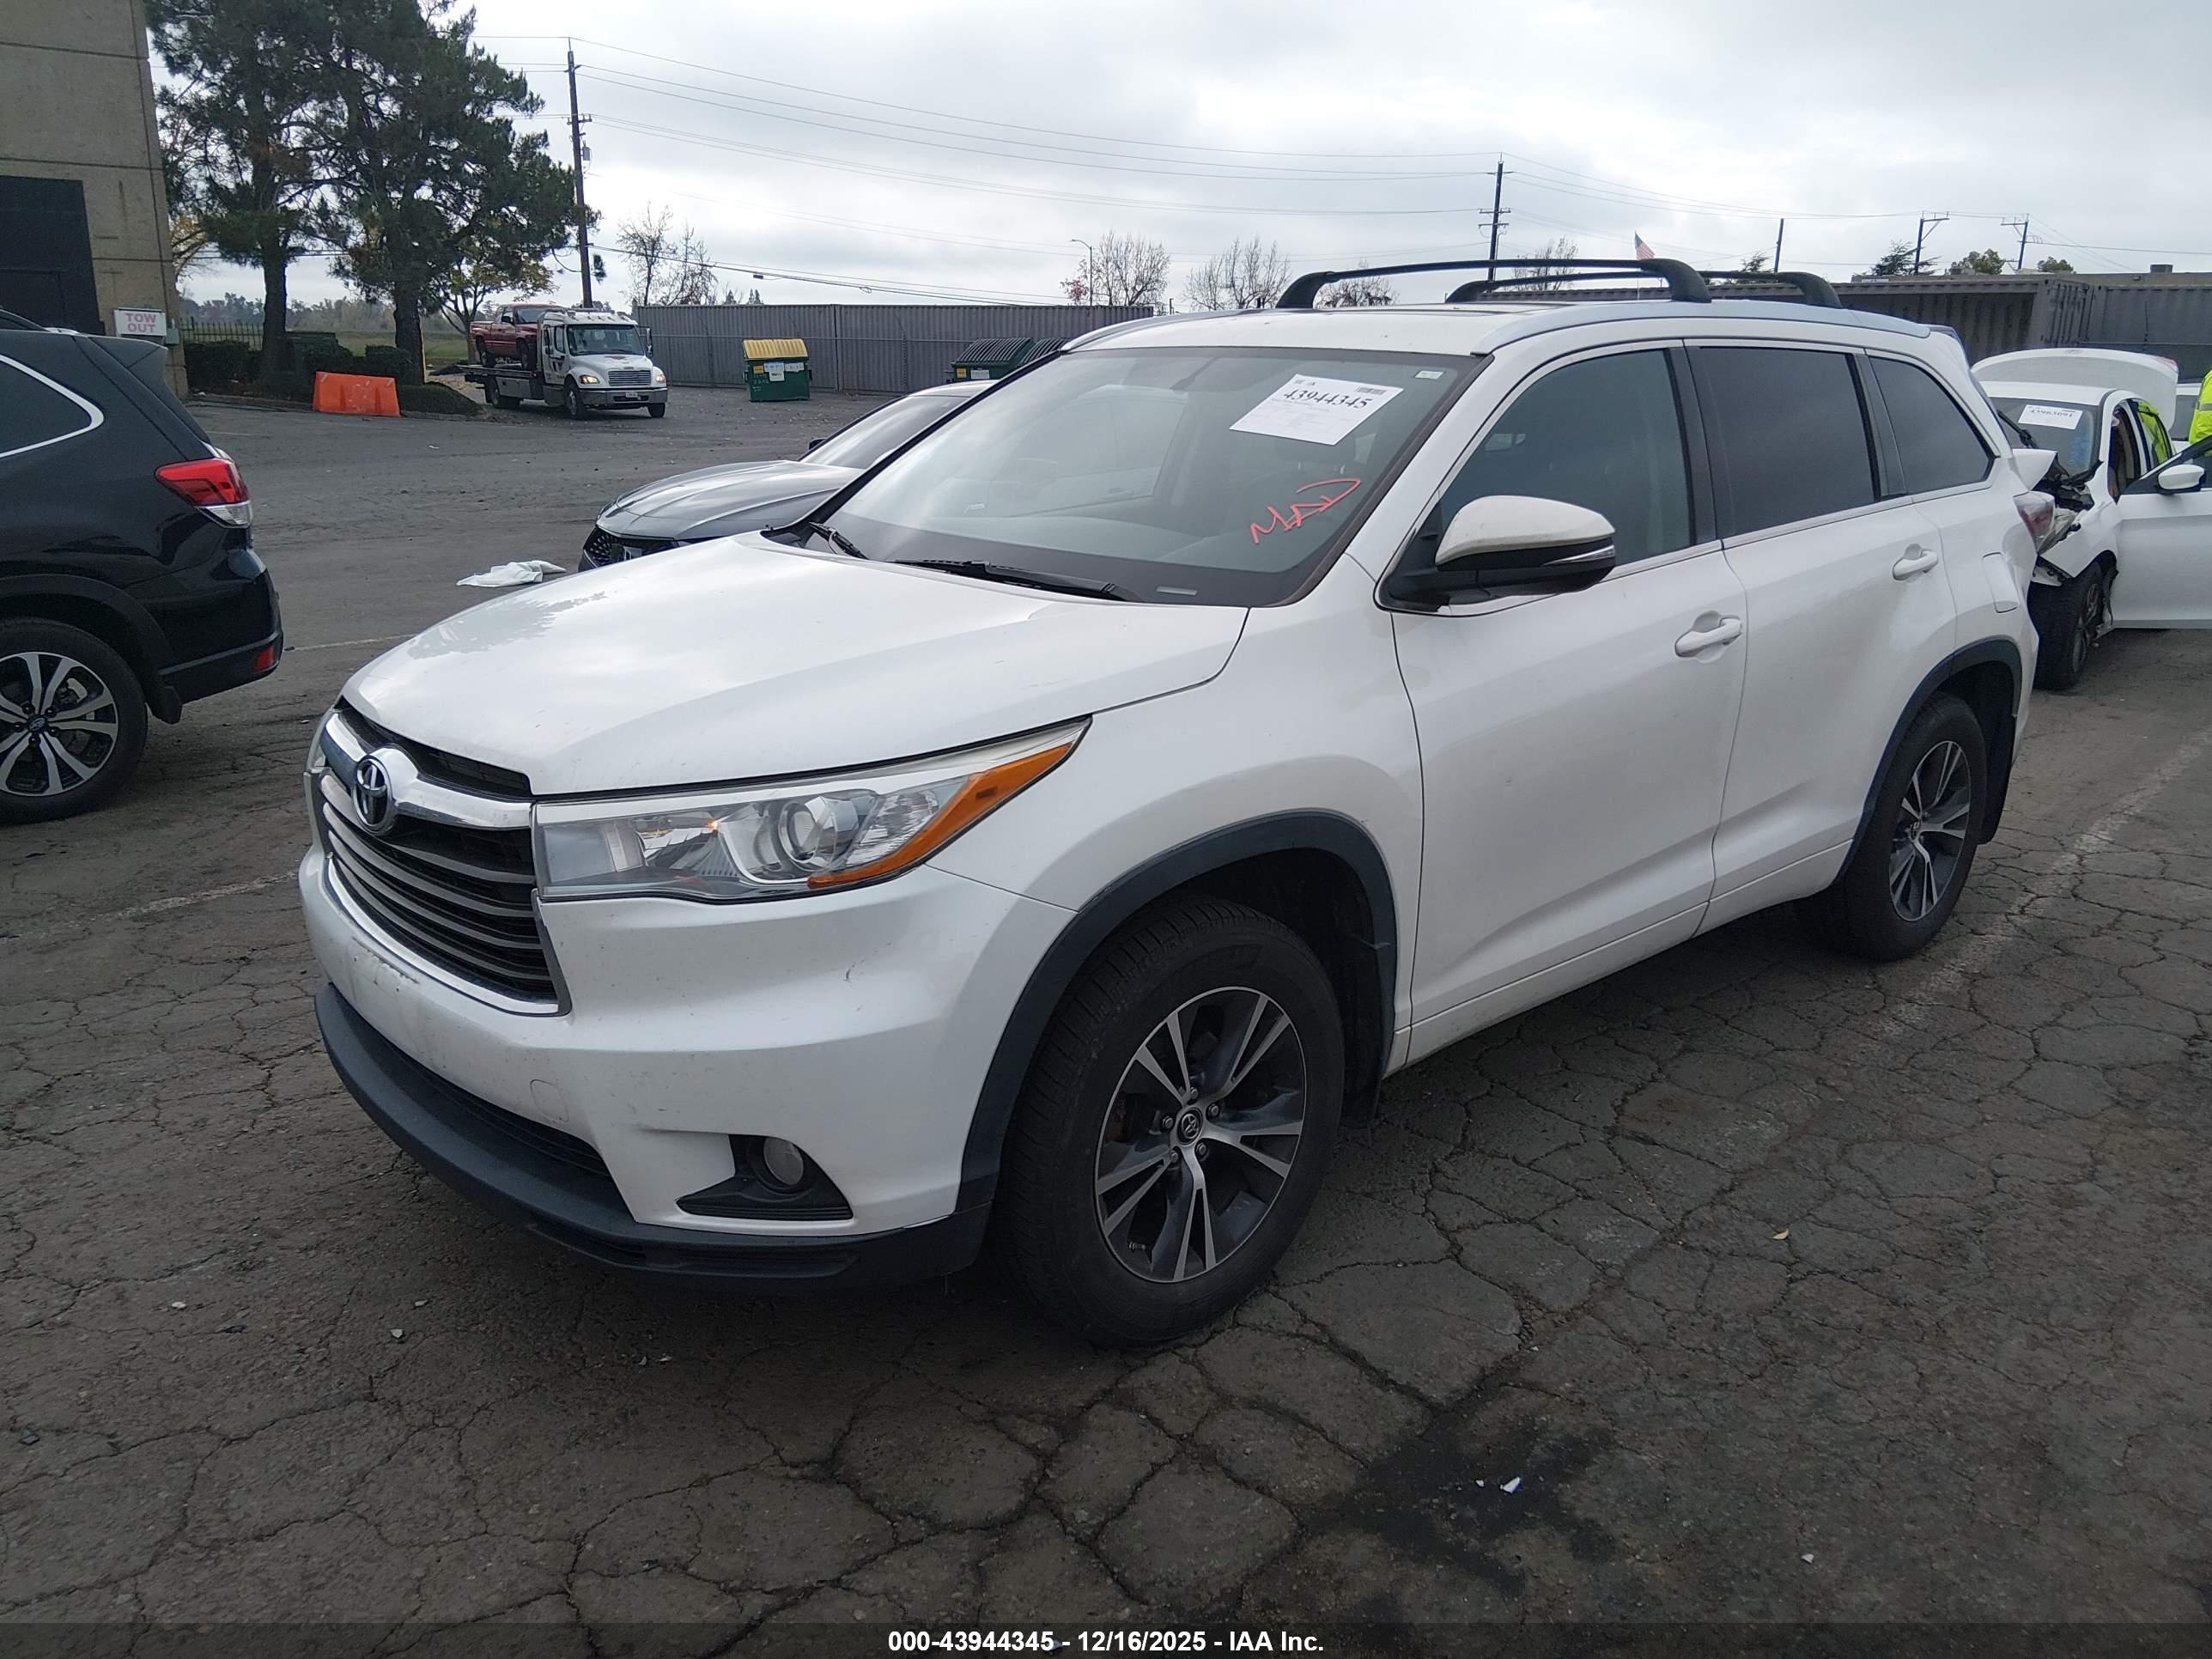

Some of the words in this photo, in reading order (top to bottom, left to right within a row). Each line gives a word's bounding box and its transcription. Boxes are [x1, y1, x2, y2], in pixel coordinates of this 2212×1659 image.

[125, 313, 156, 324] TOW
[127, 323, 156, 333] OUT
[1284, 388, 1373, 409] 43944345
